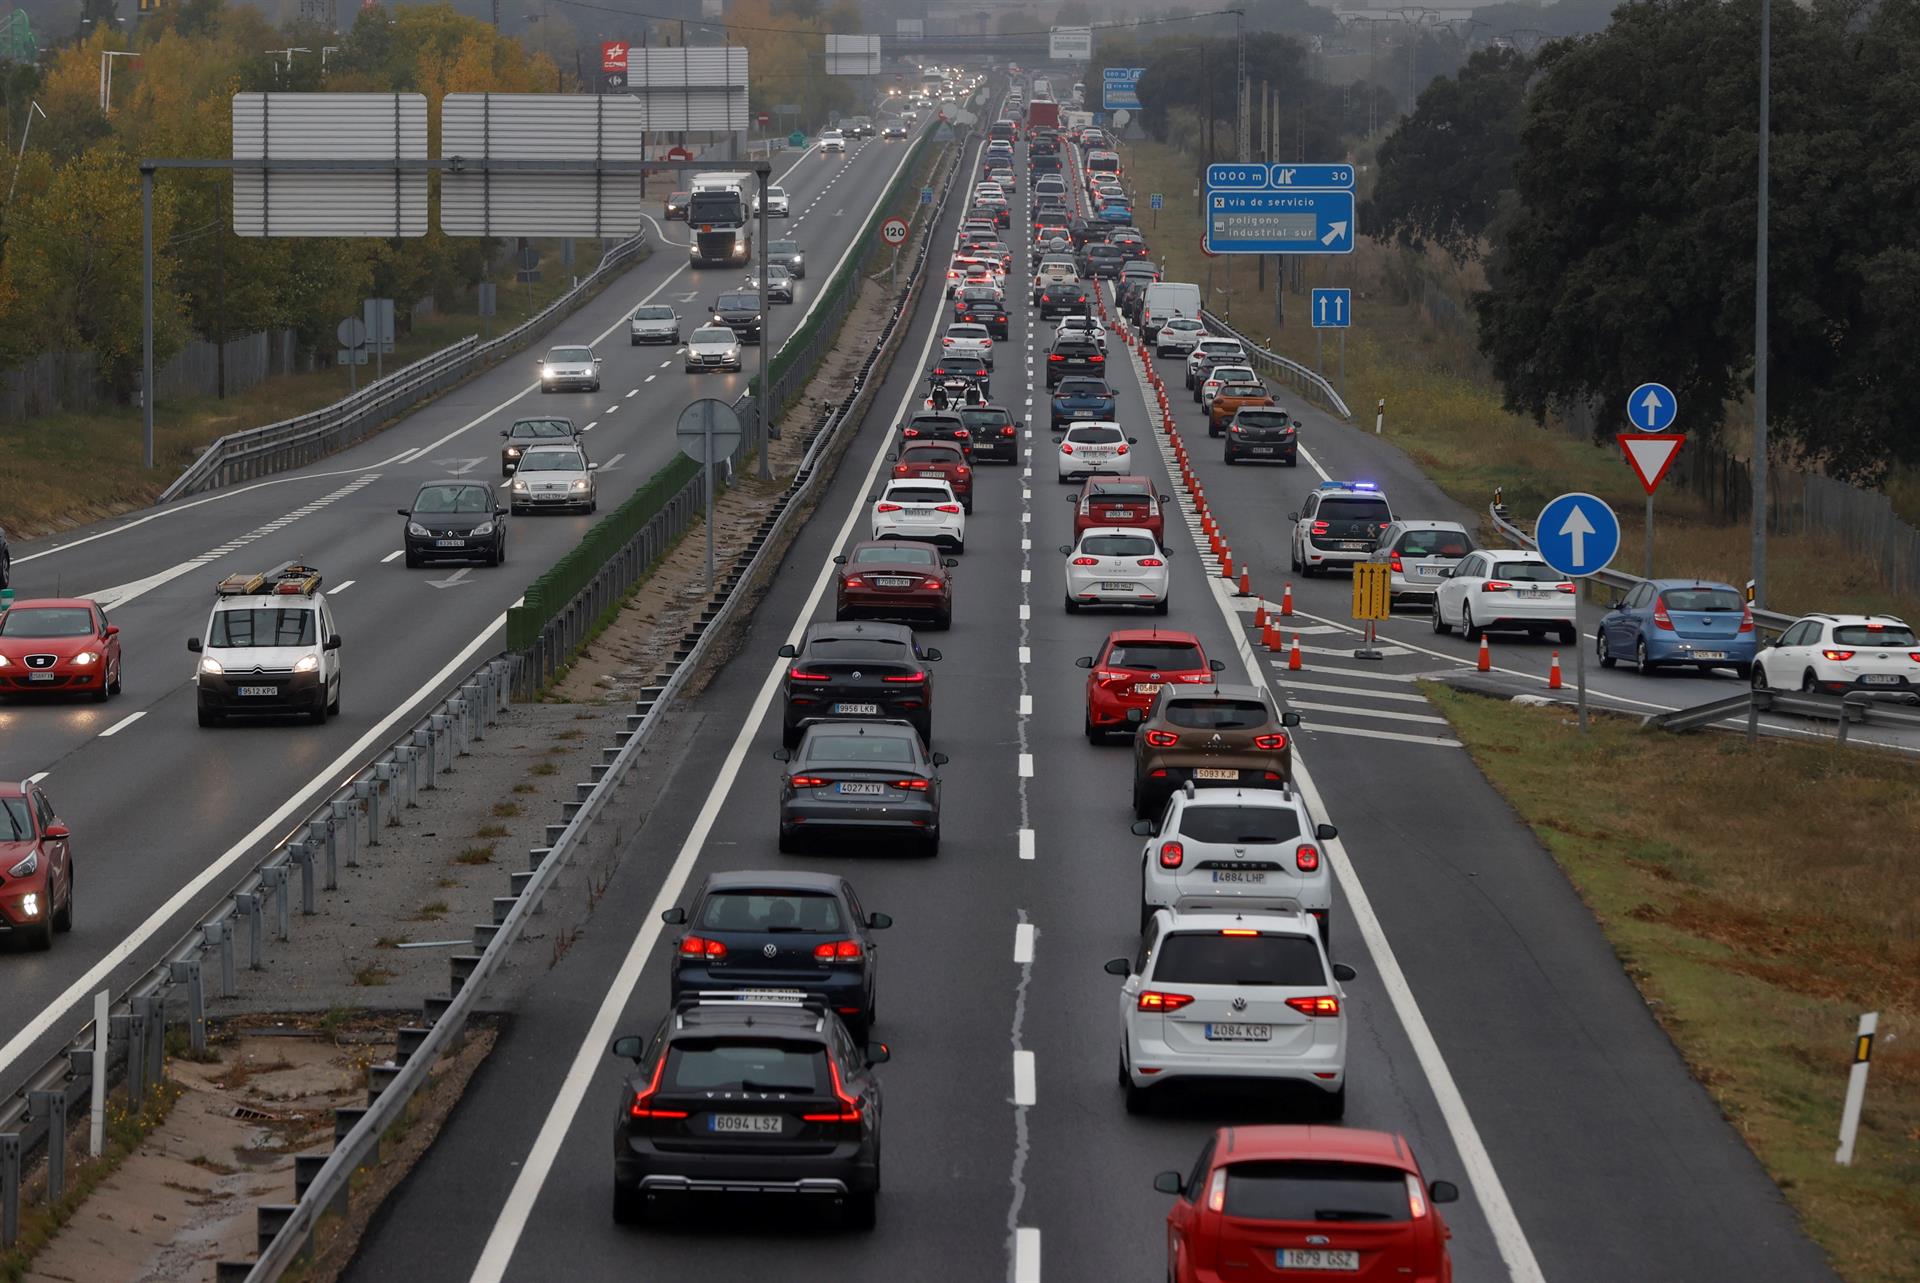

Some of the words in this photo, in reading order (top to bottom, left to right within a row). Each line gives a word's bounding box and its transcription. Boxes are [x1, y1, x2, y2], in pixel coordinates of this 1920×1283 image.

[1213, 172, 1246, 181] 1000
[1331, 172, 1348, 181] 30
[1250, 198, 1263, 206] de
[1268, 198, 1315, 206] servicio
[884, 227, 905, 237] 120
[1229, 228, 1287, 237] industrial
[243, 687, 261, 695] 9512
[262, 687, 277, 695] KPG
[839, 704, 859, 712] 9956
[860, 705, 875, 713] LKR
[1199, 769, 1219, 778] 5093
[1220, 770, 1237, 779] KJP
[841, 783, 863, 792] 4027
[864, 783, 881, 792] KTV
[1219, 873, 1244, 882] 4884
[1245, 873, 1265, 882] LHP
[1213, 1024, 1243, 1036] 4084
[1246, 1024, 1269, 1037] KCR
[707, 1091, 786, 1099] VOLVO
[717, 1116, 749, 1130] 6094
[753, 1116, 779, 1131] LSZ
[1288, 1250, 1321, 1266] 1879
[1327, 1251, 1353, 1267] GSZ
